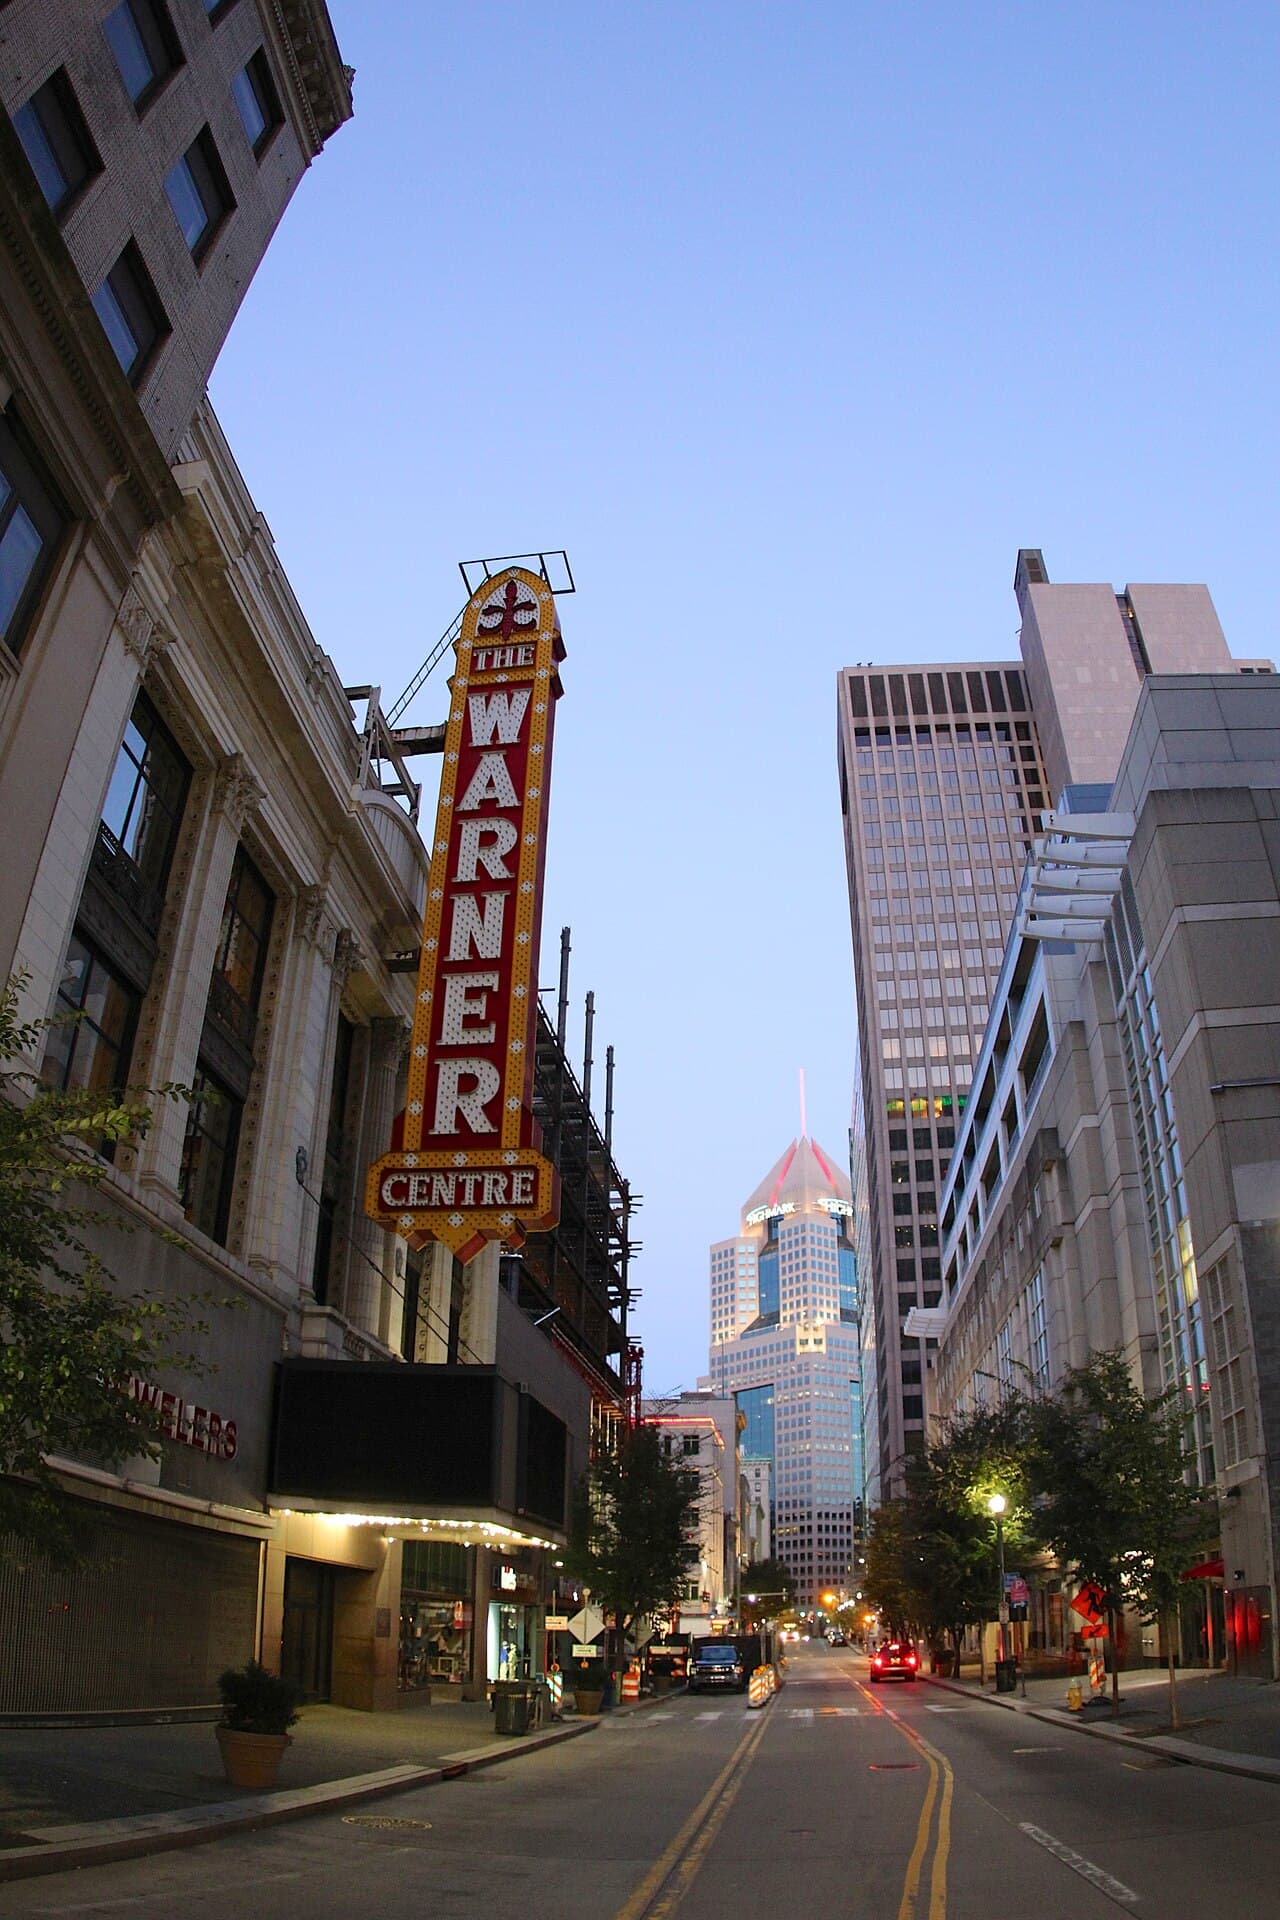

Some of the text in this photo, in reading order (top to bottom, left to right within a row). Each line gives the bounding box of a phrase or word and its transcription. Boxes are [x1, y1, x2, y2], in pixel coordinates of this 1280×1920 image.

[472, 643, 536, 671] THE
[429, 687, 534, 1136] WARNER
[381, 1169, 535, 1207] CENTRE
